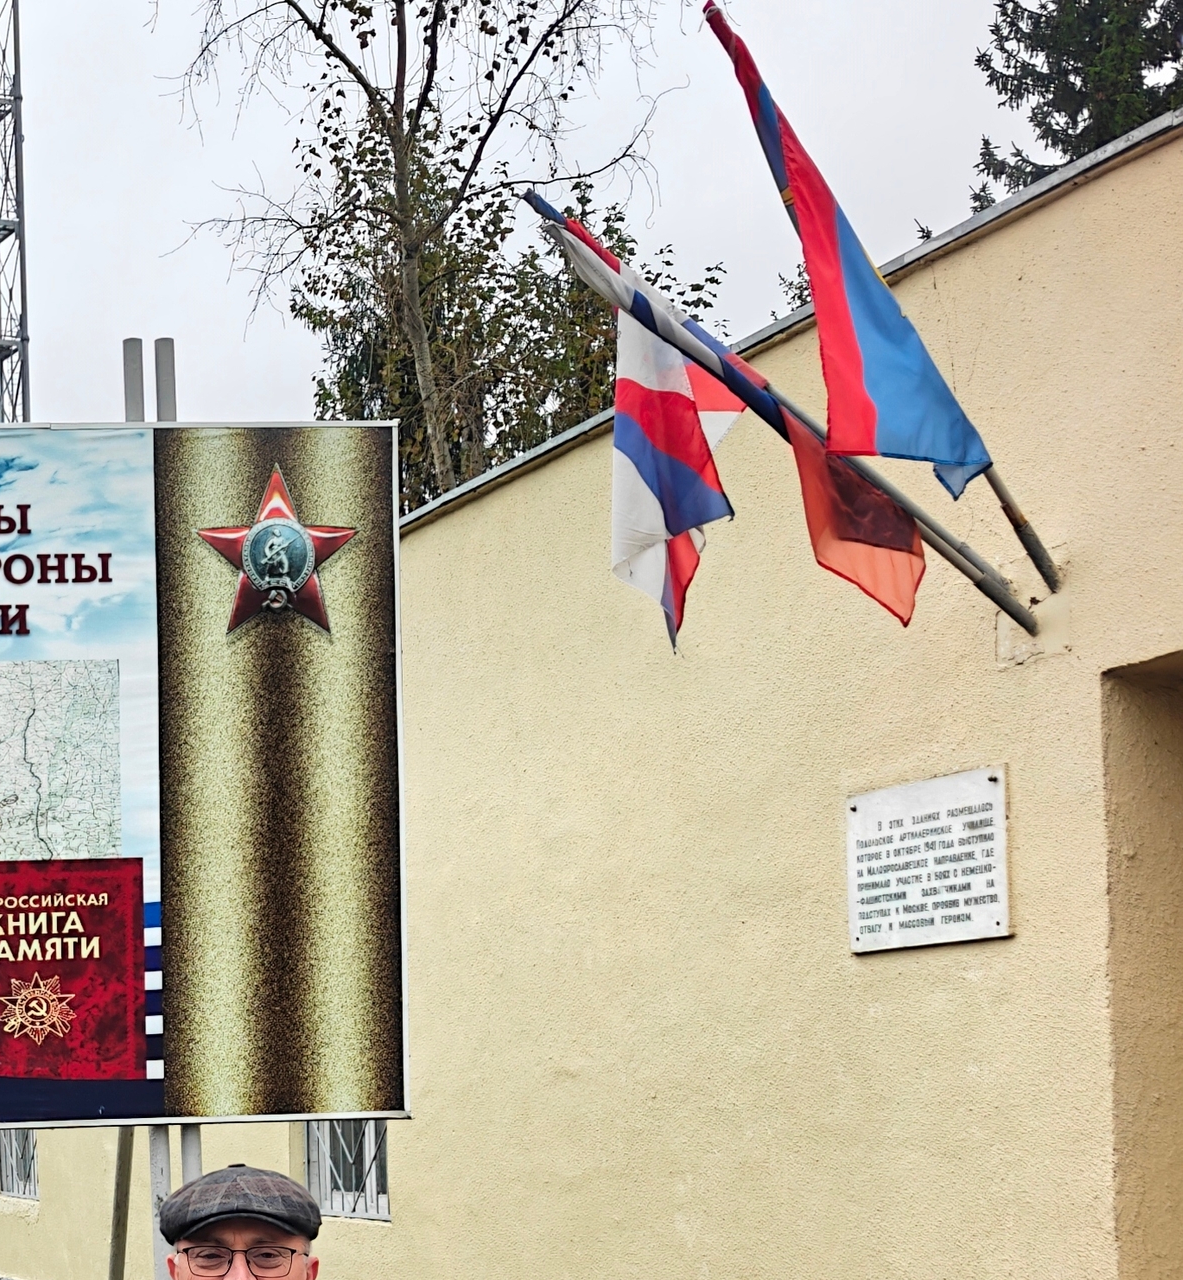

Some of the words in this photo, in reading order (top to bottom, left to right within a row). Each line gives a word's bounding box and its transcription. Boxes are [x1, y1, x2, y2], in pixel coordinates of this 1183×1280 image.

[877, 820, 883, 832] В
[938, 839, 955, 850] ГОДА
[982, 847, 995, 859] ГДЕ
[986, 878, 995, 889] НА
